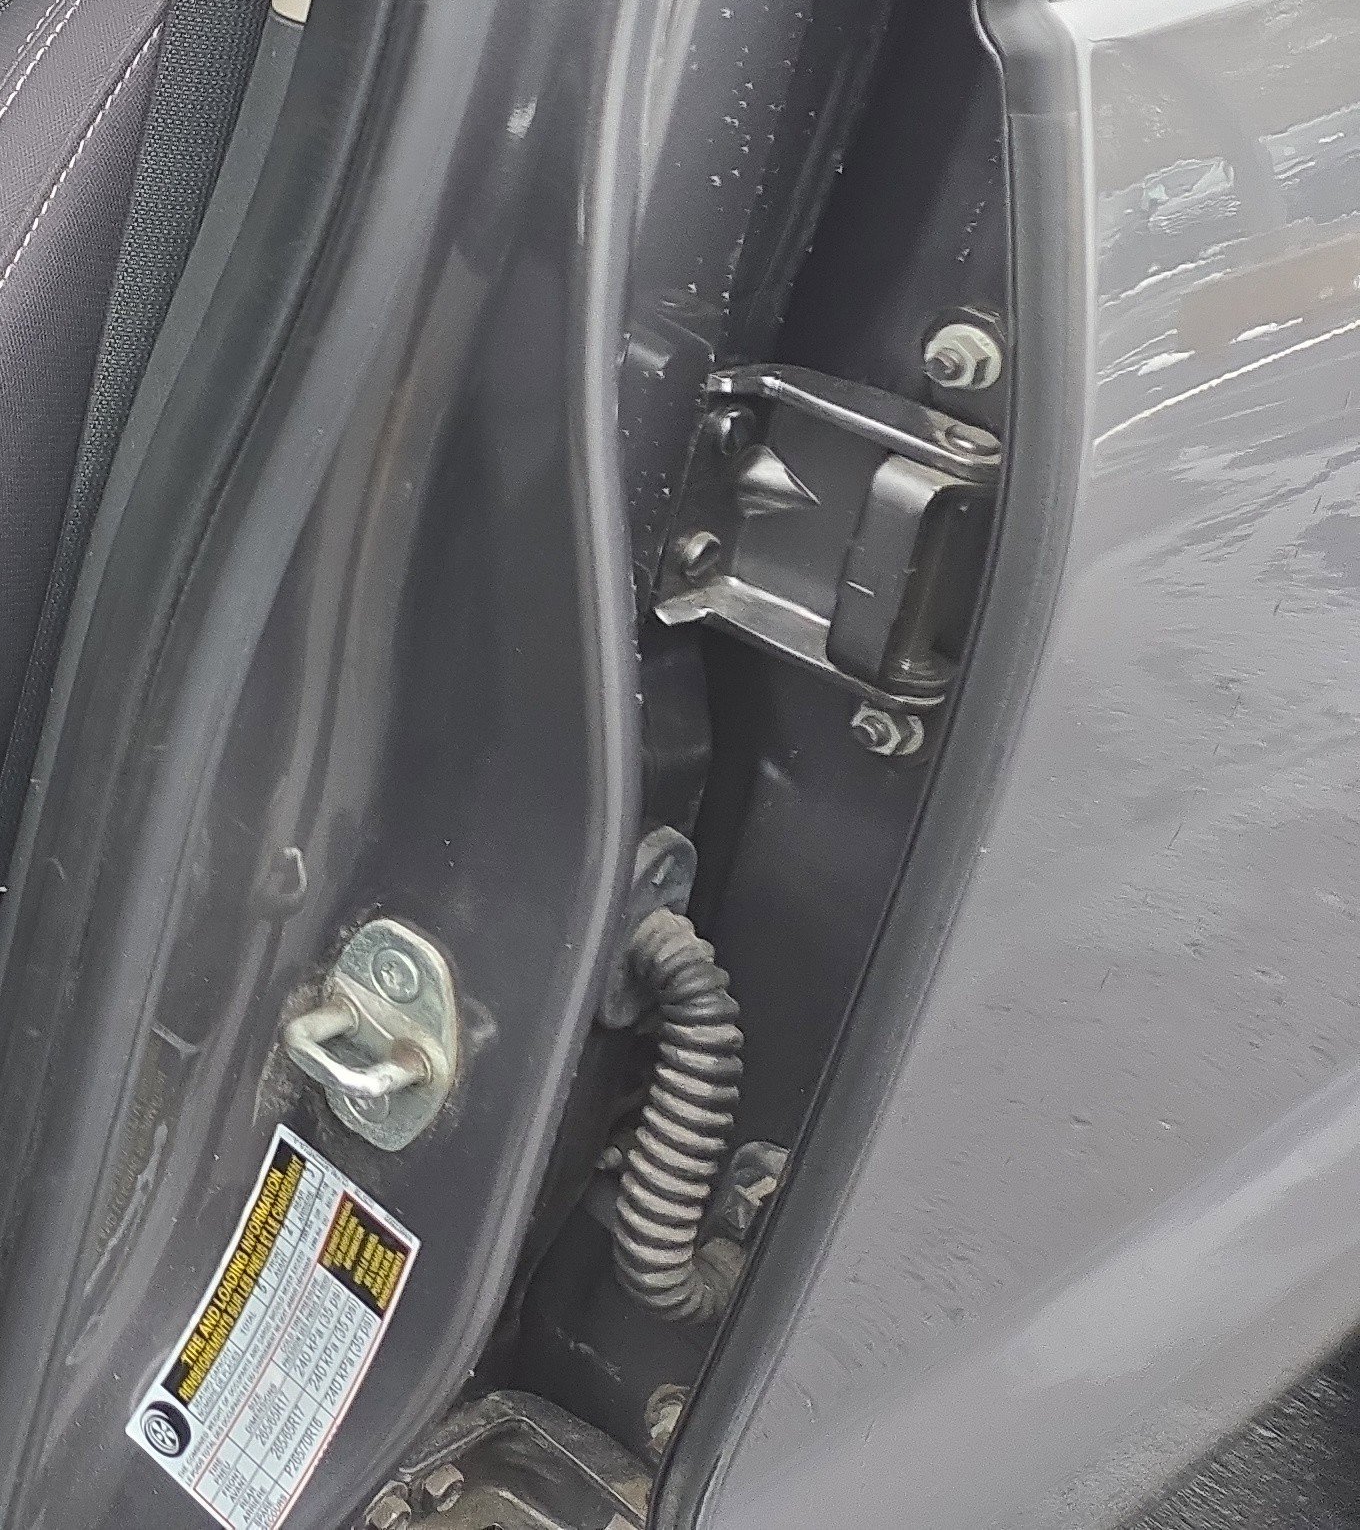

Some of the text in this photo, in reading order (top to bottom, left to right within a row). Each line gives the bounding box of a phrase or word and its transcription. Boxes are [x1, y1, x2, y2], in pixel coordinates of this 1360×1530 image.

[280, 1221, 294, 1236] 2
[179, 1165, 284, 1368] TIRE AND LOADING INFORMATION
[239, 1308, 256, 1336] TOTAL
[293, 1349, 312, 1377] 240
[305, 1325, 324, 1353] kPa
[316, 1303, 334, 1330] (35
[326, 1280, 345, 1310] psi)
[306, 1294, 361, 1391] 240 kPa (35 psi)
[322, 1377, 343, 1406] 240
[335, 1354, 355, 1381] kPa
[347, 1332, 365, 1358] (35
[358, 1309, 377, 1338] psi)
[283, 1415, 324, 1478] P265/70R16
[221, 1466, 242, 1497] FRONT
[228, 1473, 248, 1503] AVANT
